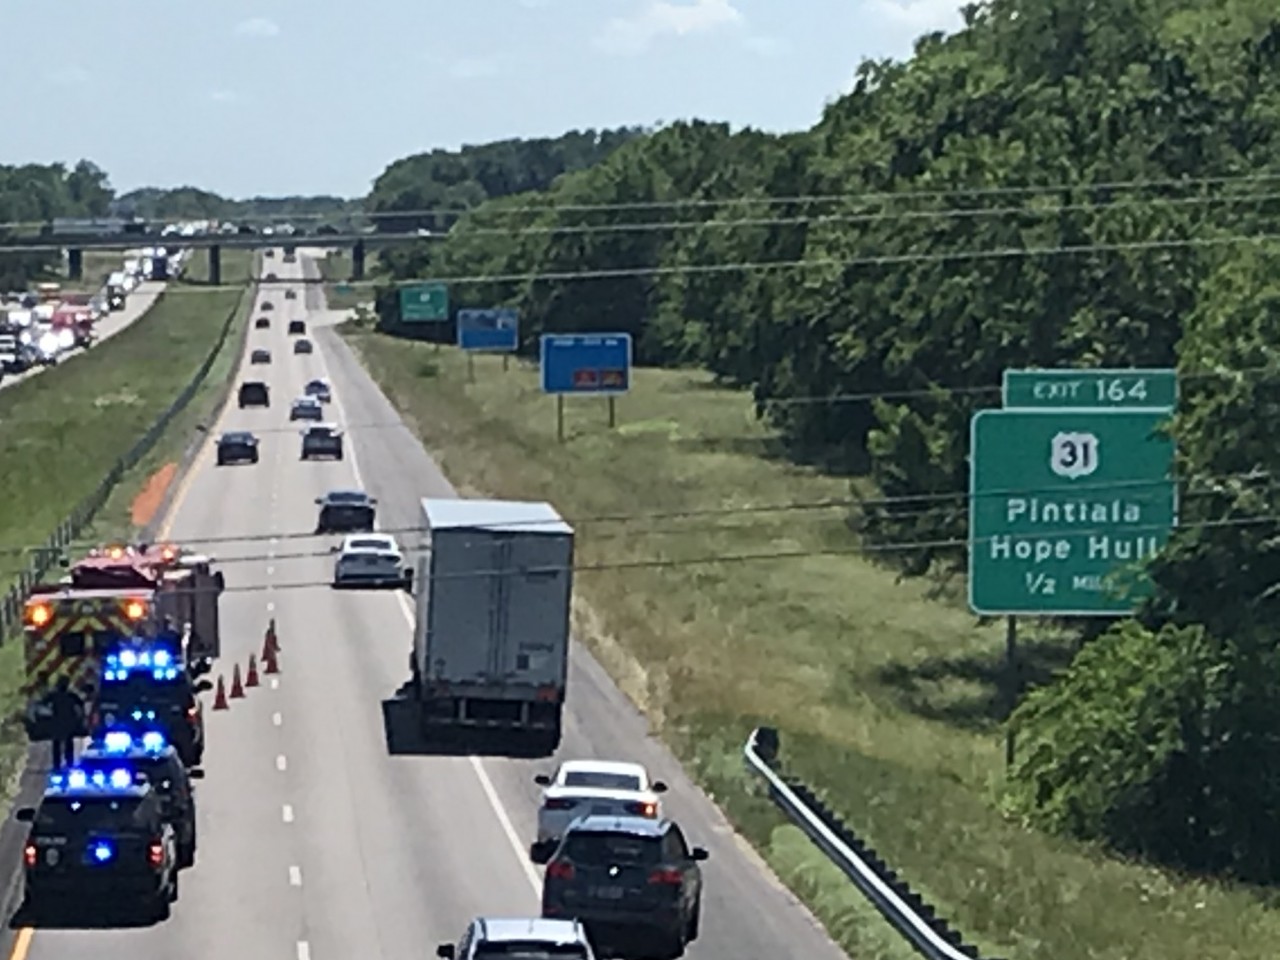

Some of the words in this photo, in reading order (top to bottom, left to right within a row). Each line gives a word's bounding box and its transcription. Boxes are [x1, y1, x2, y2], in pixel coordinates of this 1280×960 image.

[1033, 382, 1081, 399] EXIT
[1097, 380, 1148, 401] 164
[1060, 440, 1090, 468] 31
[990, 535, 1071, 563] Hope
[1088, 536, 1158, 560] Hull
[1072, 575, 1118, 591] MIL
